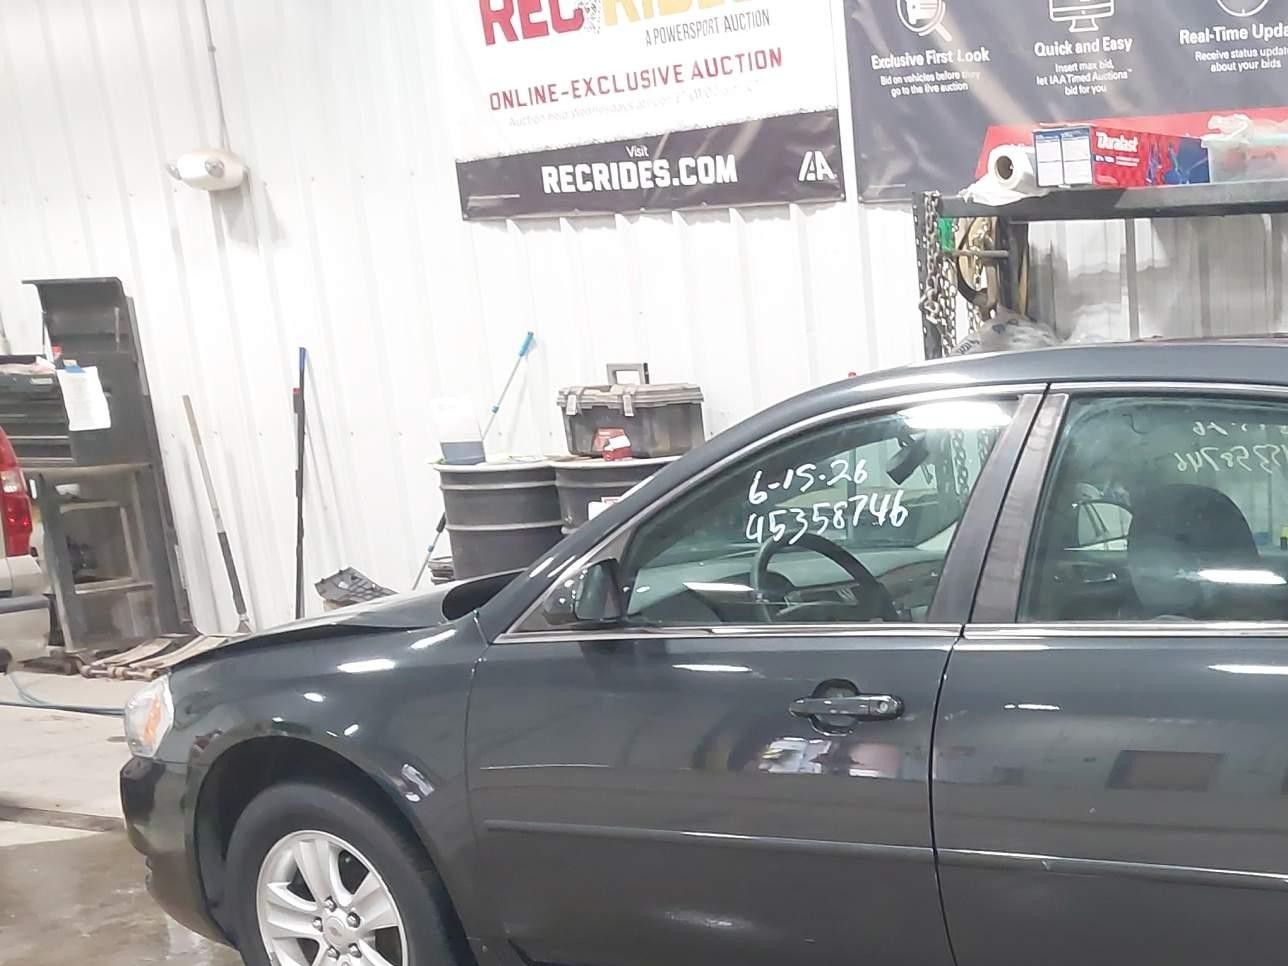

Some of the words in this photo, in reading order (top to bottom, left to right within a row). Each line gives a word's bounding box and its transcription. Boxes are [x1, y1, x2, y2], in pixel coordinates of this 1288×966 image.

[645, 30, 652, 47] A
[653, 17, 719, 45] POWERSPORT
[723, 9, 770, 33] AUCTION
[1179, 26, 1248, 45] Real-Time
[1034, 40, 1072, 57] Quick
[1075, 38, 1099, 54] and
[1102, 36, 1133, 52] Easy
[1195, 50, 1229, 62] Receive
[1230, 48, 1258, 59] status
[871, 52, 924, 70] Exclusive
[925, 49, 953, 65] First
[957, 47, 990, 62] Look
[1055, 62, 1078, 73] Insert
[1079, 62, 1097, 71] max
[1210, 61, 1237, 73] about
[1238, 60, 1259, 72] your
[1261, 58, 1282, 69] bids
[489, 63, 684, 111] ONLINE-EXCLUSIVE
[691, 47, 782, 80] AUCTION
[880, 75, 892, 86] Bid
[904, 72, 935, 83] vehicles
[935, 70, 960, 81] before
[1036, 75, 1048, 86] let
[1049, 74, 1066, 85] IAA
[1066, 72, 1091, 83] Timed
[891, 88, 901, 98] go
[901, 86, 910, 95] to
[911, 85, 923, 95] the
[924, 83, 939, 93] live
[940, 81, 968, 93] auction
[1064, 85, 1078, 96] bid
[1079, 84, 1089, 94] for
[1091, 84, 1107, 94] you
[626, 144, 648, 158] Visit
[1095, 131, 1138, 153] Duralast
[541, 154, 738, 194] RECRIDES.COM
[745, 489, 909, 545] 45358746
